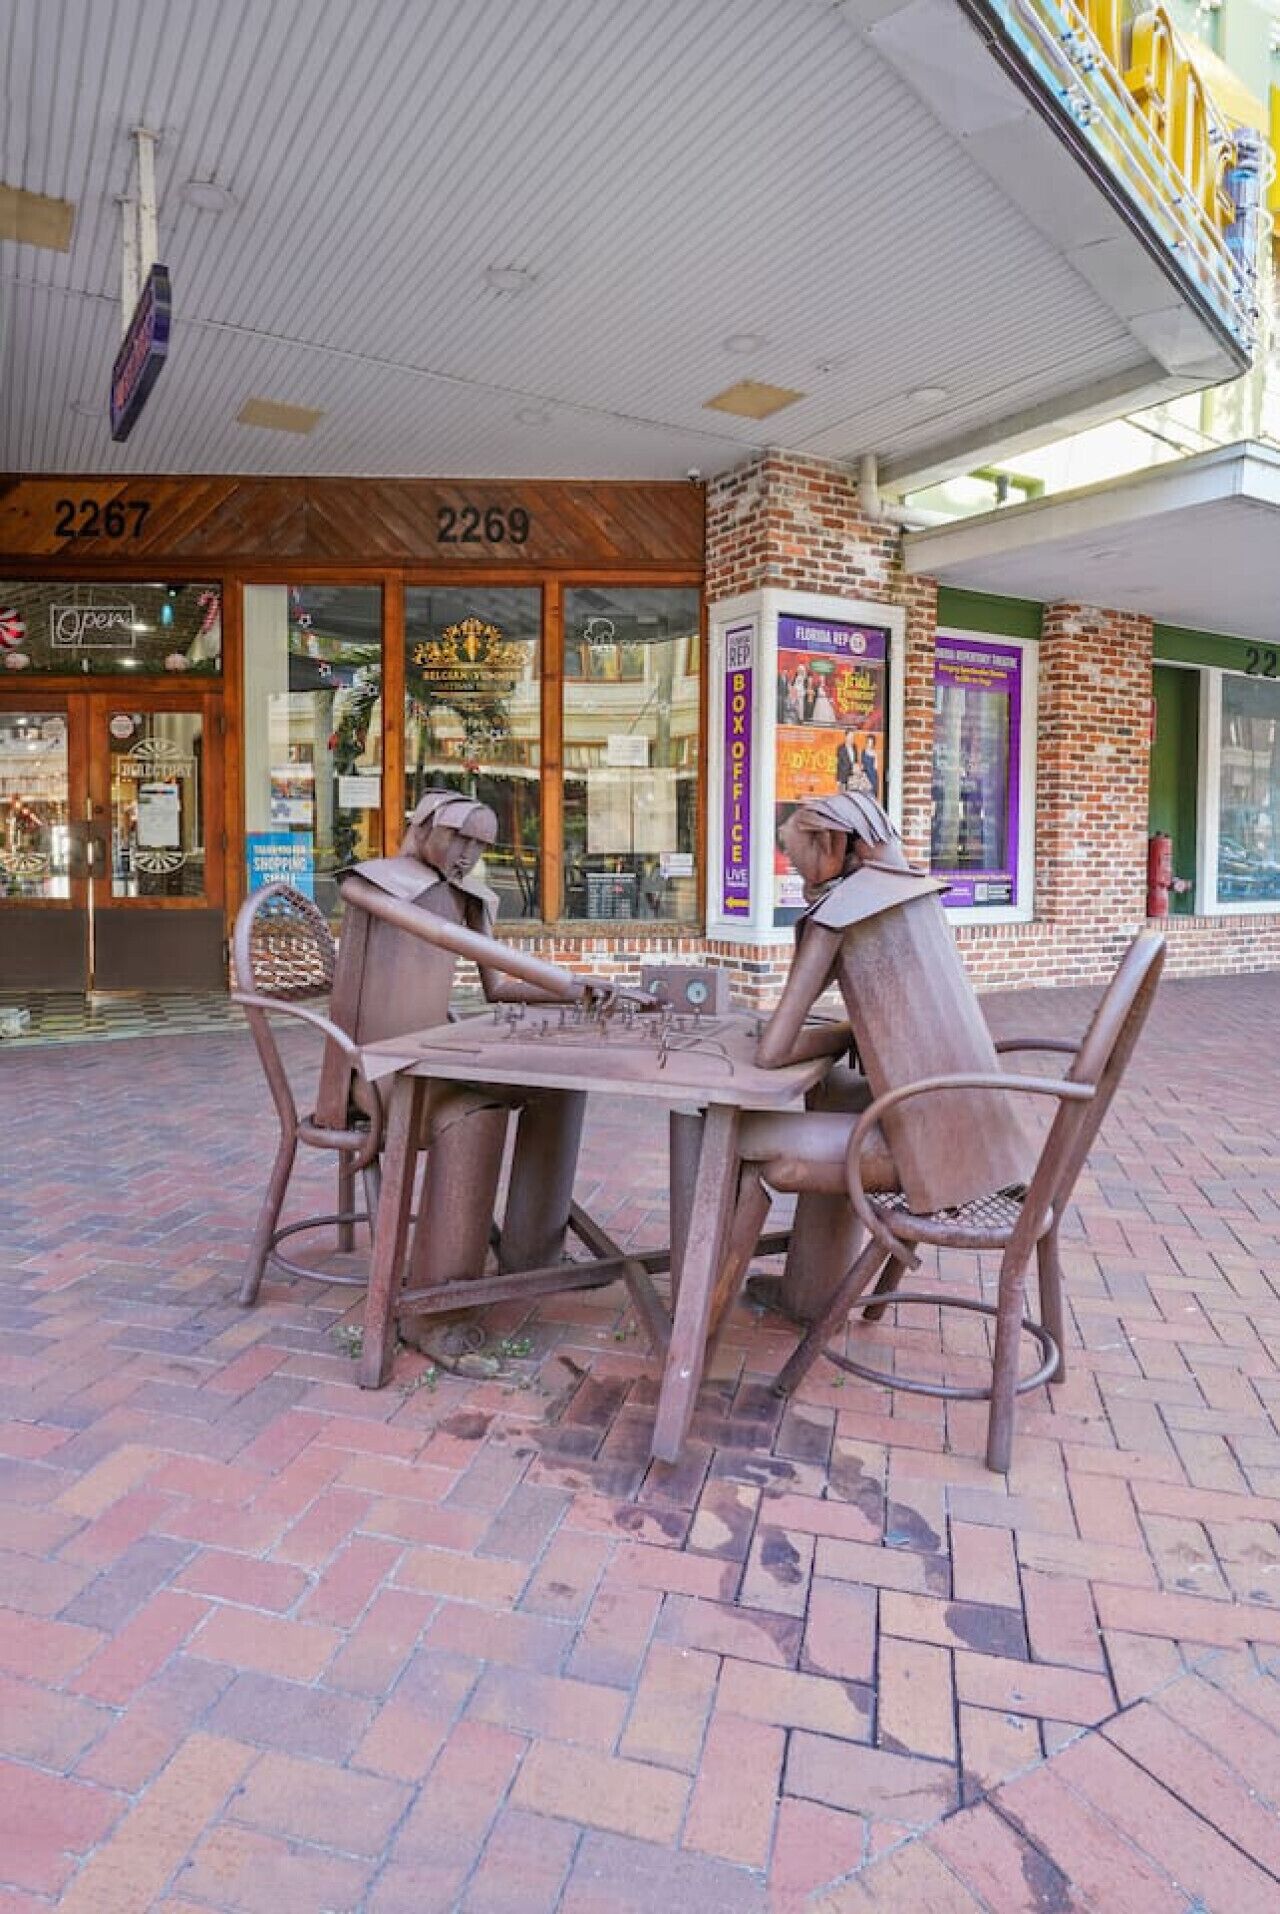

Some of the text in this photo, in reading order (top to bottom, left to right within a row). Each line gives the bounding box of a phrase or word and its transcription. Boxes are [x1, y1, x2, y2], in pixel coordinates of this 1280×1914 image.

[54, 499, 151, 538] 2267
[437, 506, 530, 544] 2269
[795, 625, 832, 644] FLORIDA
[732, 673, 746, 862] BOX OFFICE
[253, 856, 306, 872] SHOPPING
